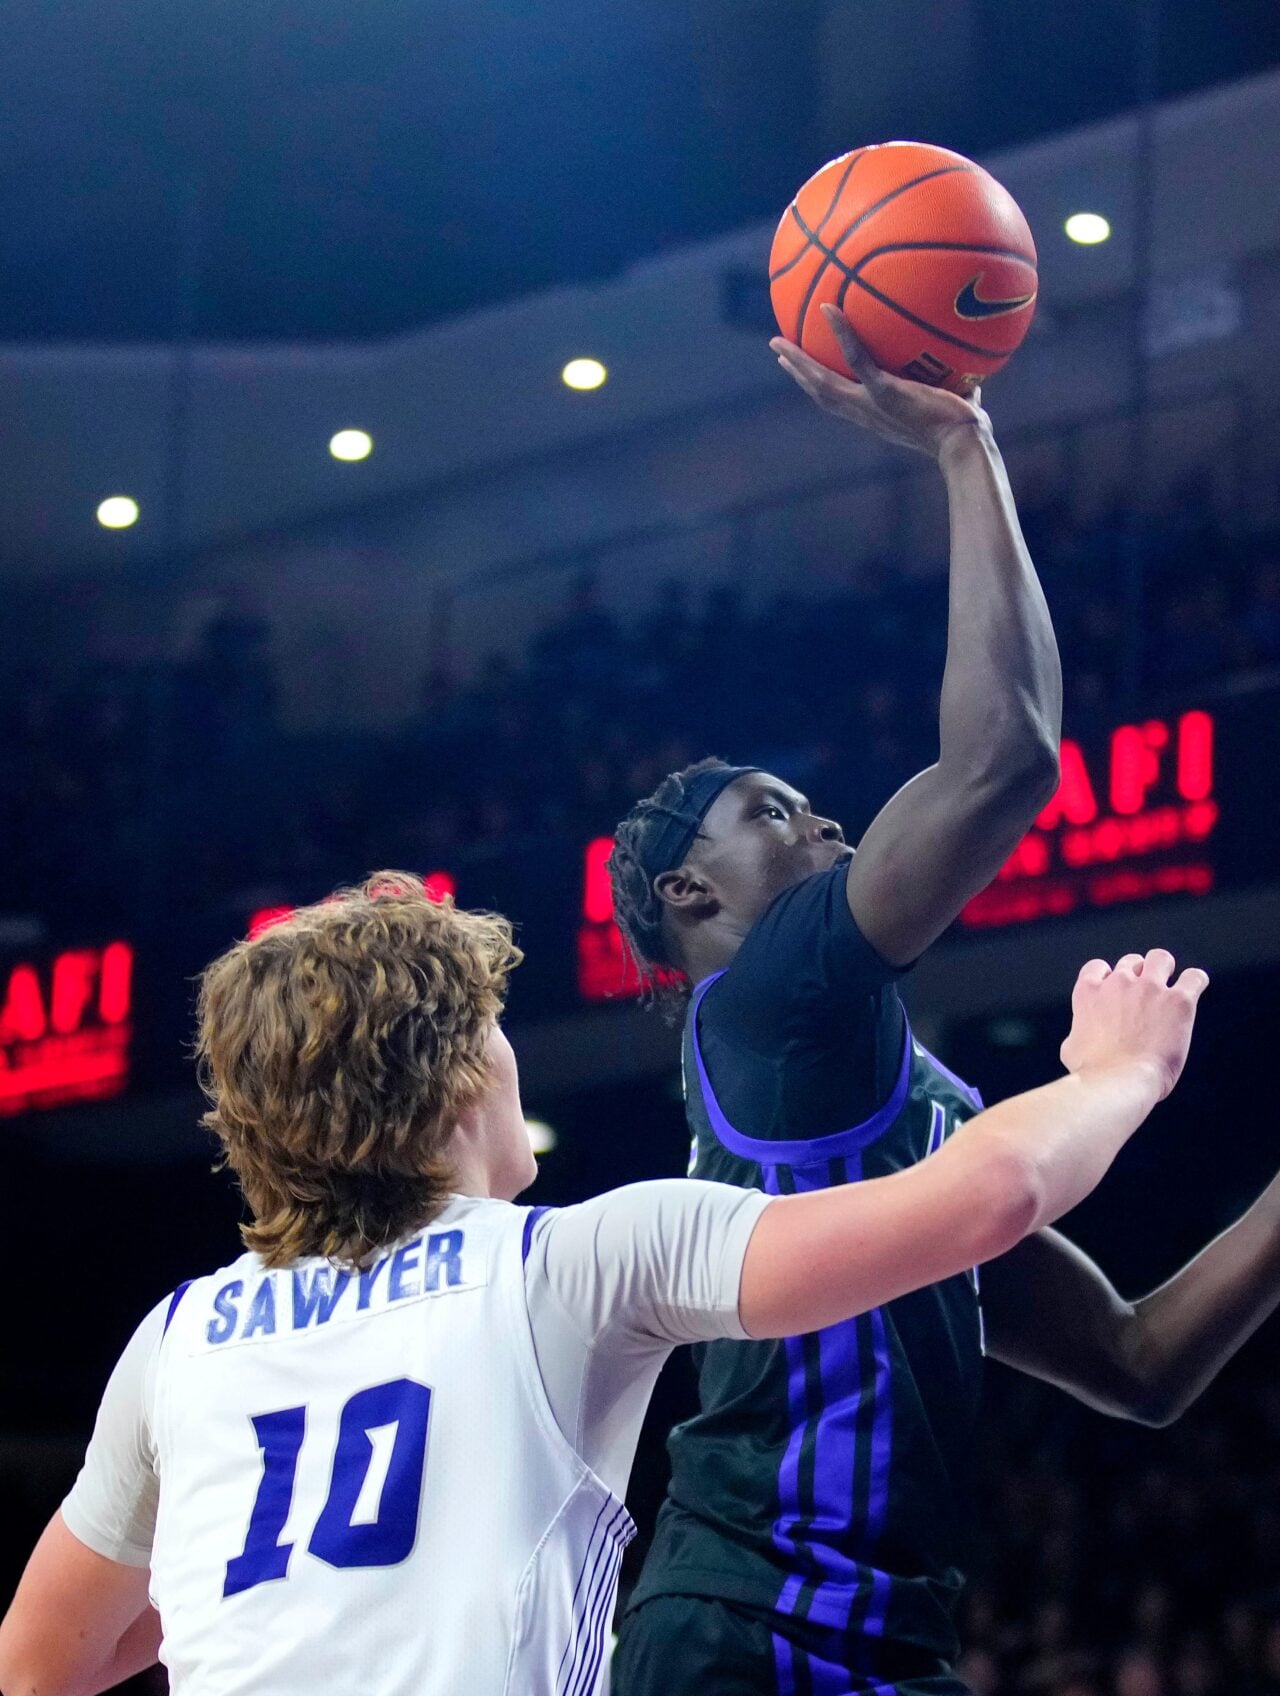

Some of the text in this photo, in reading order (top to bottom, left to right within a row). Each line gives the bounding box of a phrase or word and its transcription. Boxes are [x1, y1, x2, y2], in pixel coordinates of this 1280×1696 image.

[1035, 710, 1214, 831] AFI
[207, 1229, 465, 1345] SAWYER
[221, 1375, 436, 1602] 10
